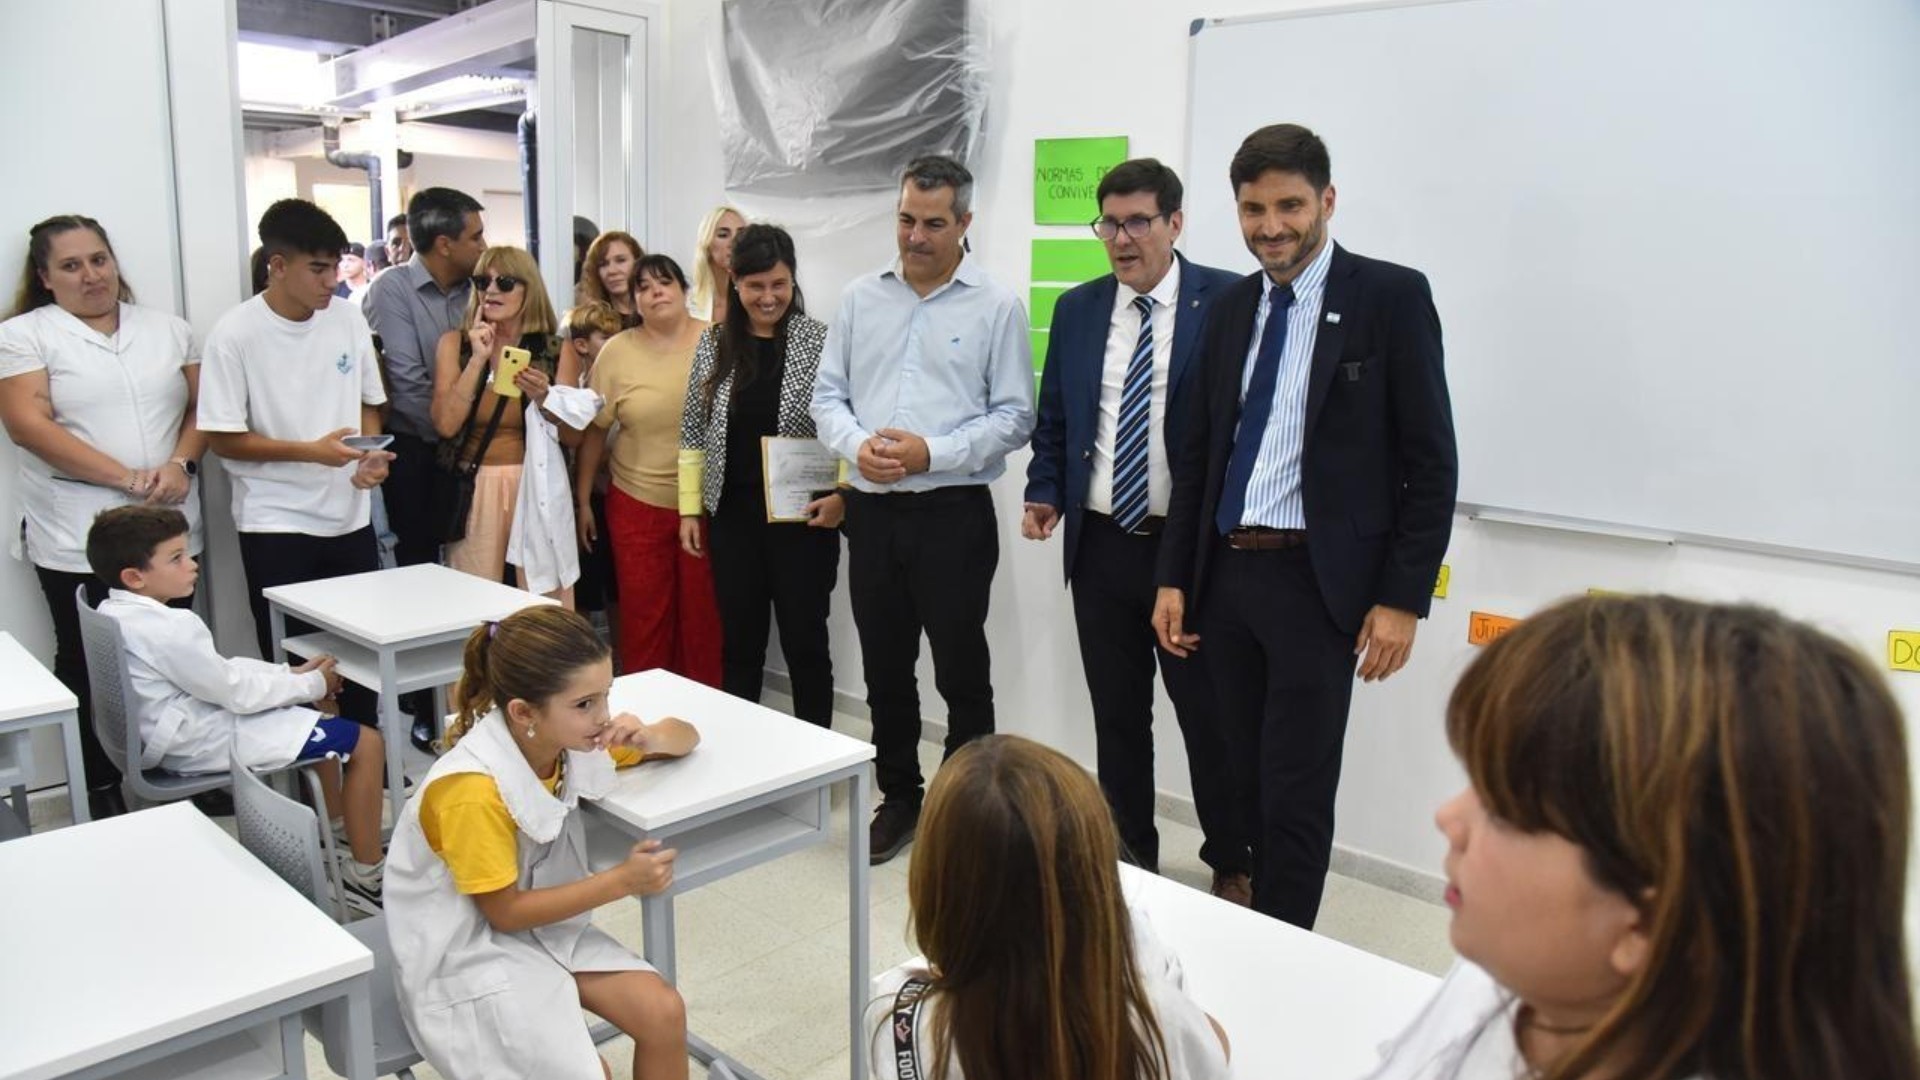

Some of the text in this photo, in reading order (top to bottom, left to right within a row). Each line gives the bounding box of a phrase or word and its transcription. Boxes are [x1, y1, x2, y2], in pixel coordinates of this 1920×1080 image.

[1036, 167, 1083, 182] NORMAS
[1048, 184, 1095, 200] CONVIVE
[898, 1050, 916, 1080] FOO
